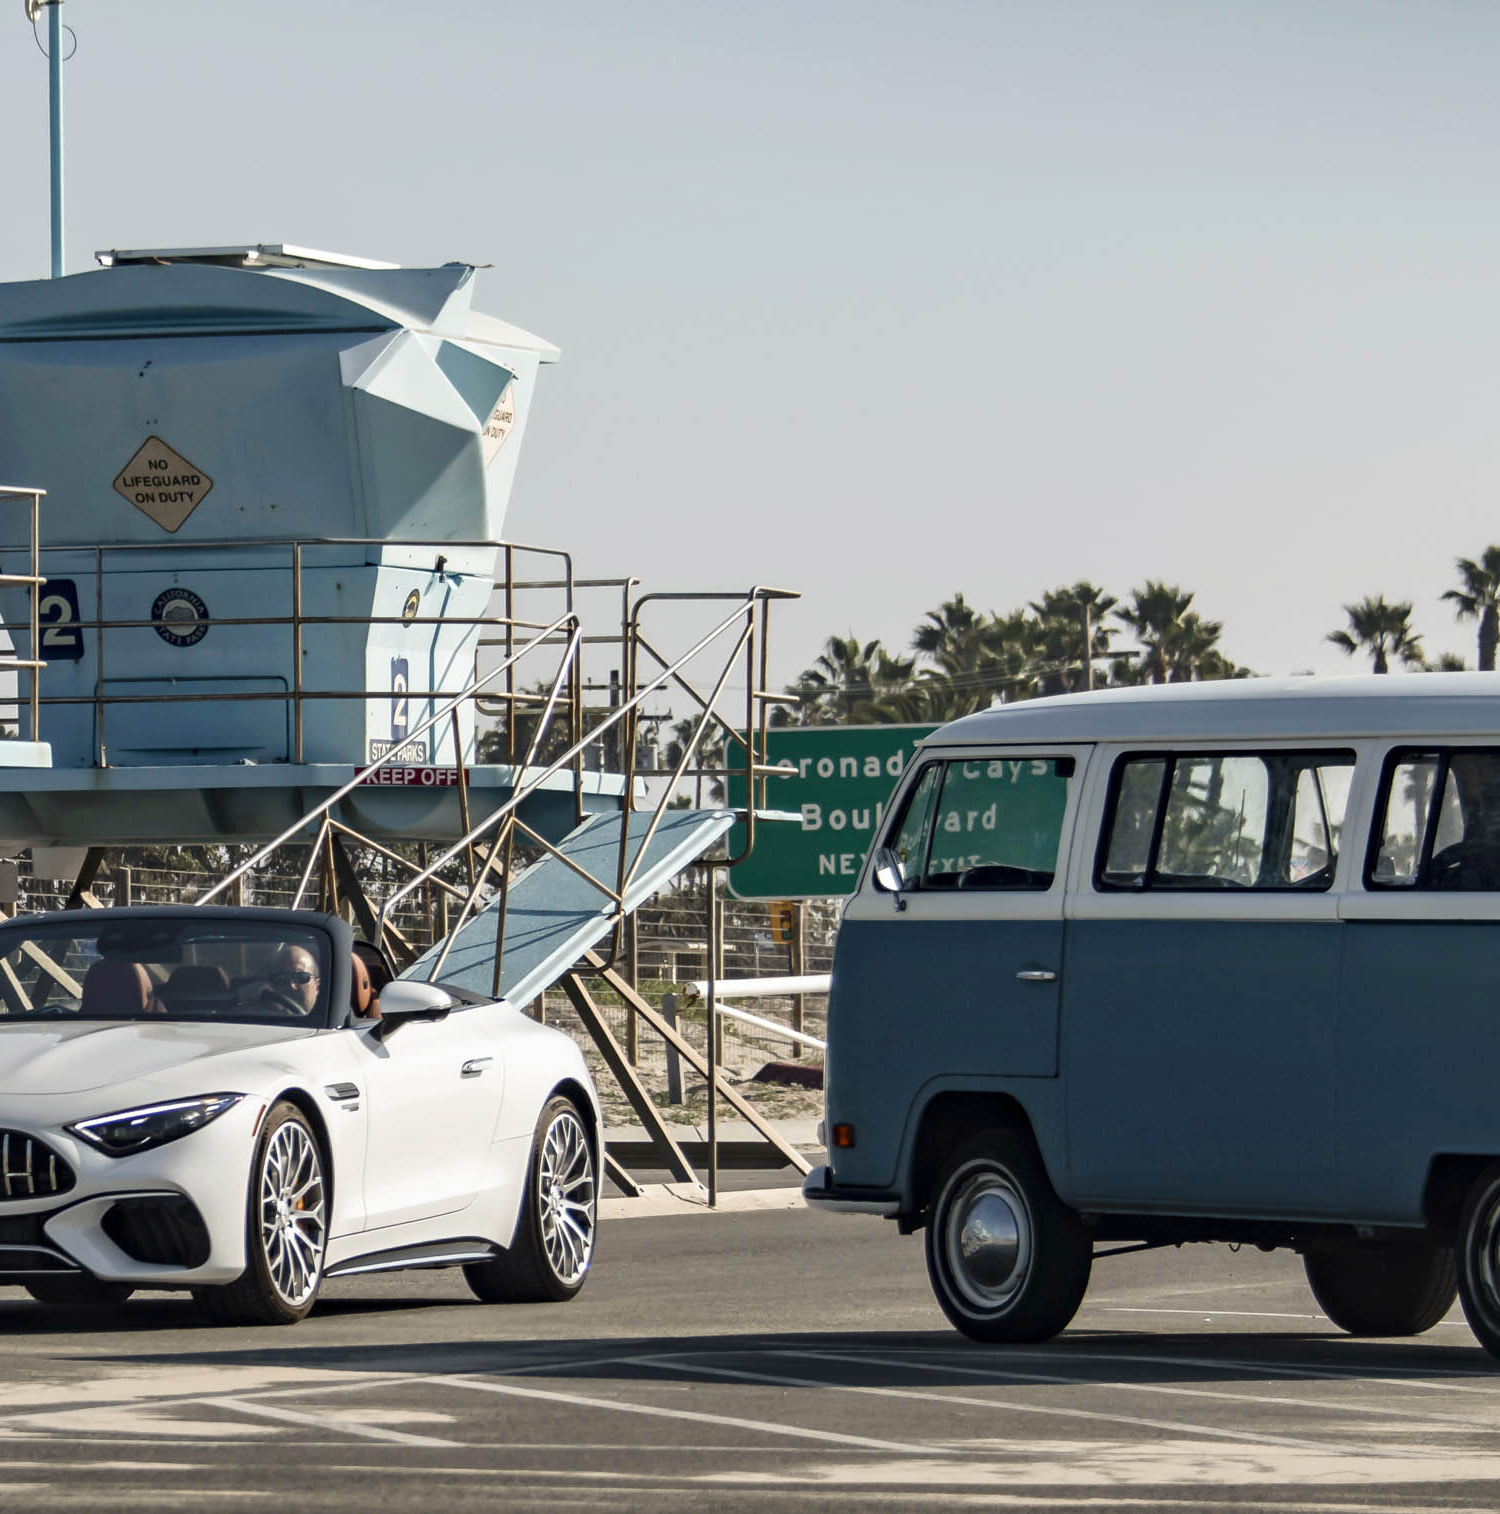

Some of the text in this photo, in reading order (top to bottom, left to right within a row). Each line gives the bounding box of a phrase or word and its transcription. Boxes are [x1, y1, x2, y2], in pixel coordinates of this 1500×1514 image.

[147, 459, 169, 471] NO
[122, 475, 201, 488] LIFEGUARD
[135, 491, 195, 504] ON DUTY
[40, 595, 76, 647] 2
[393, 673, 408, 727] 2
[366, 768, 459, 786] KEEP OFF
